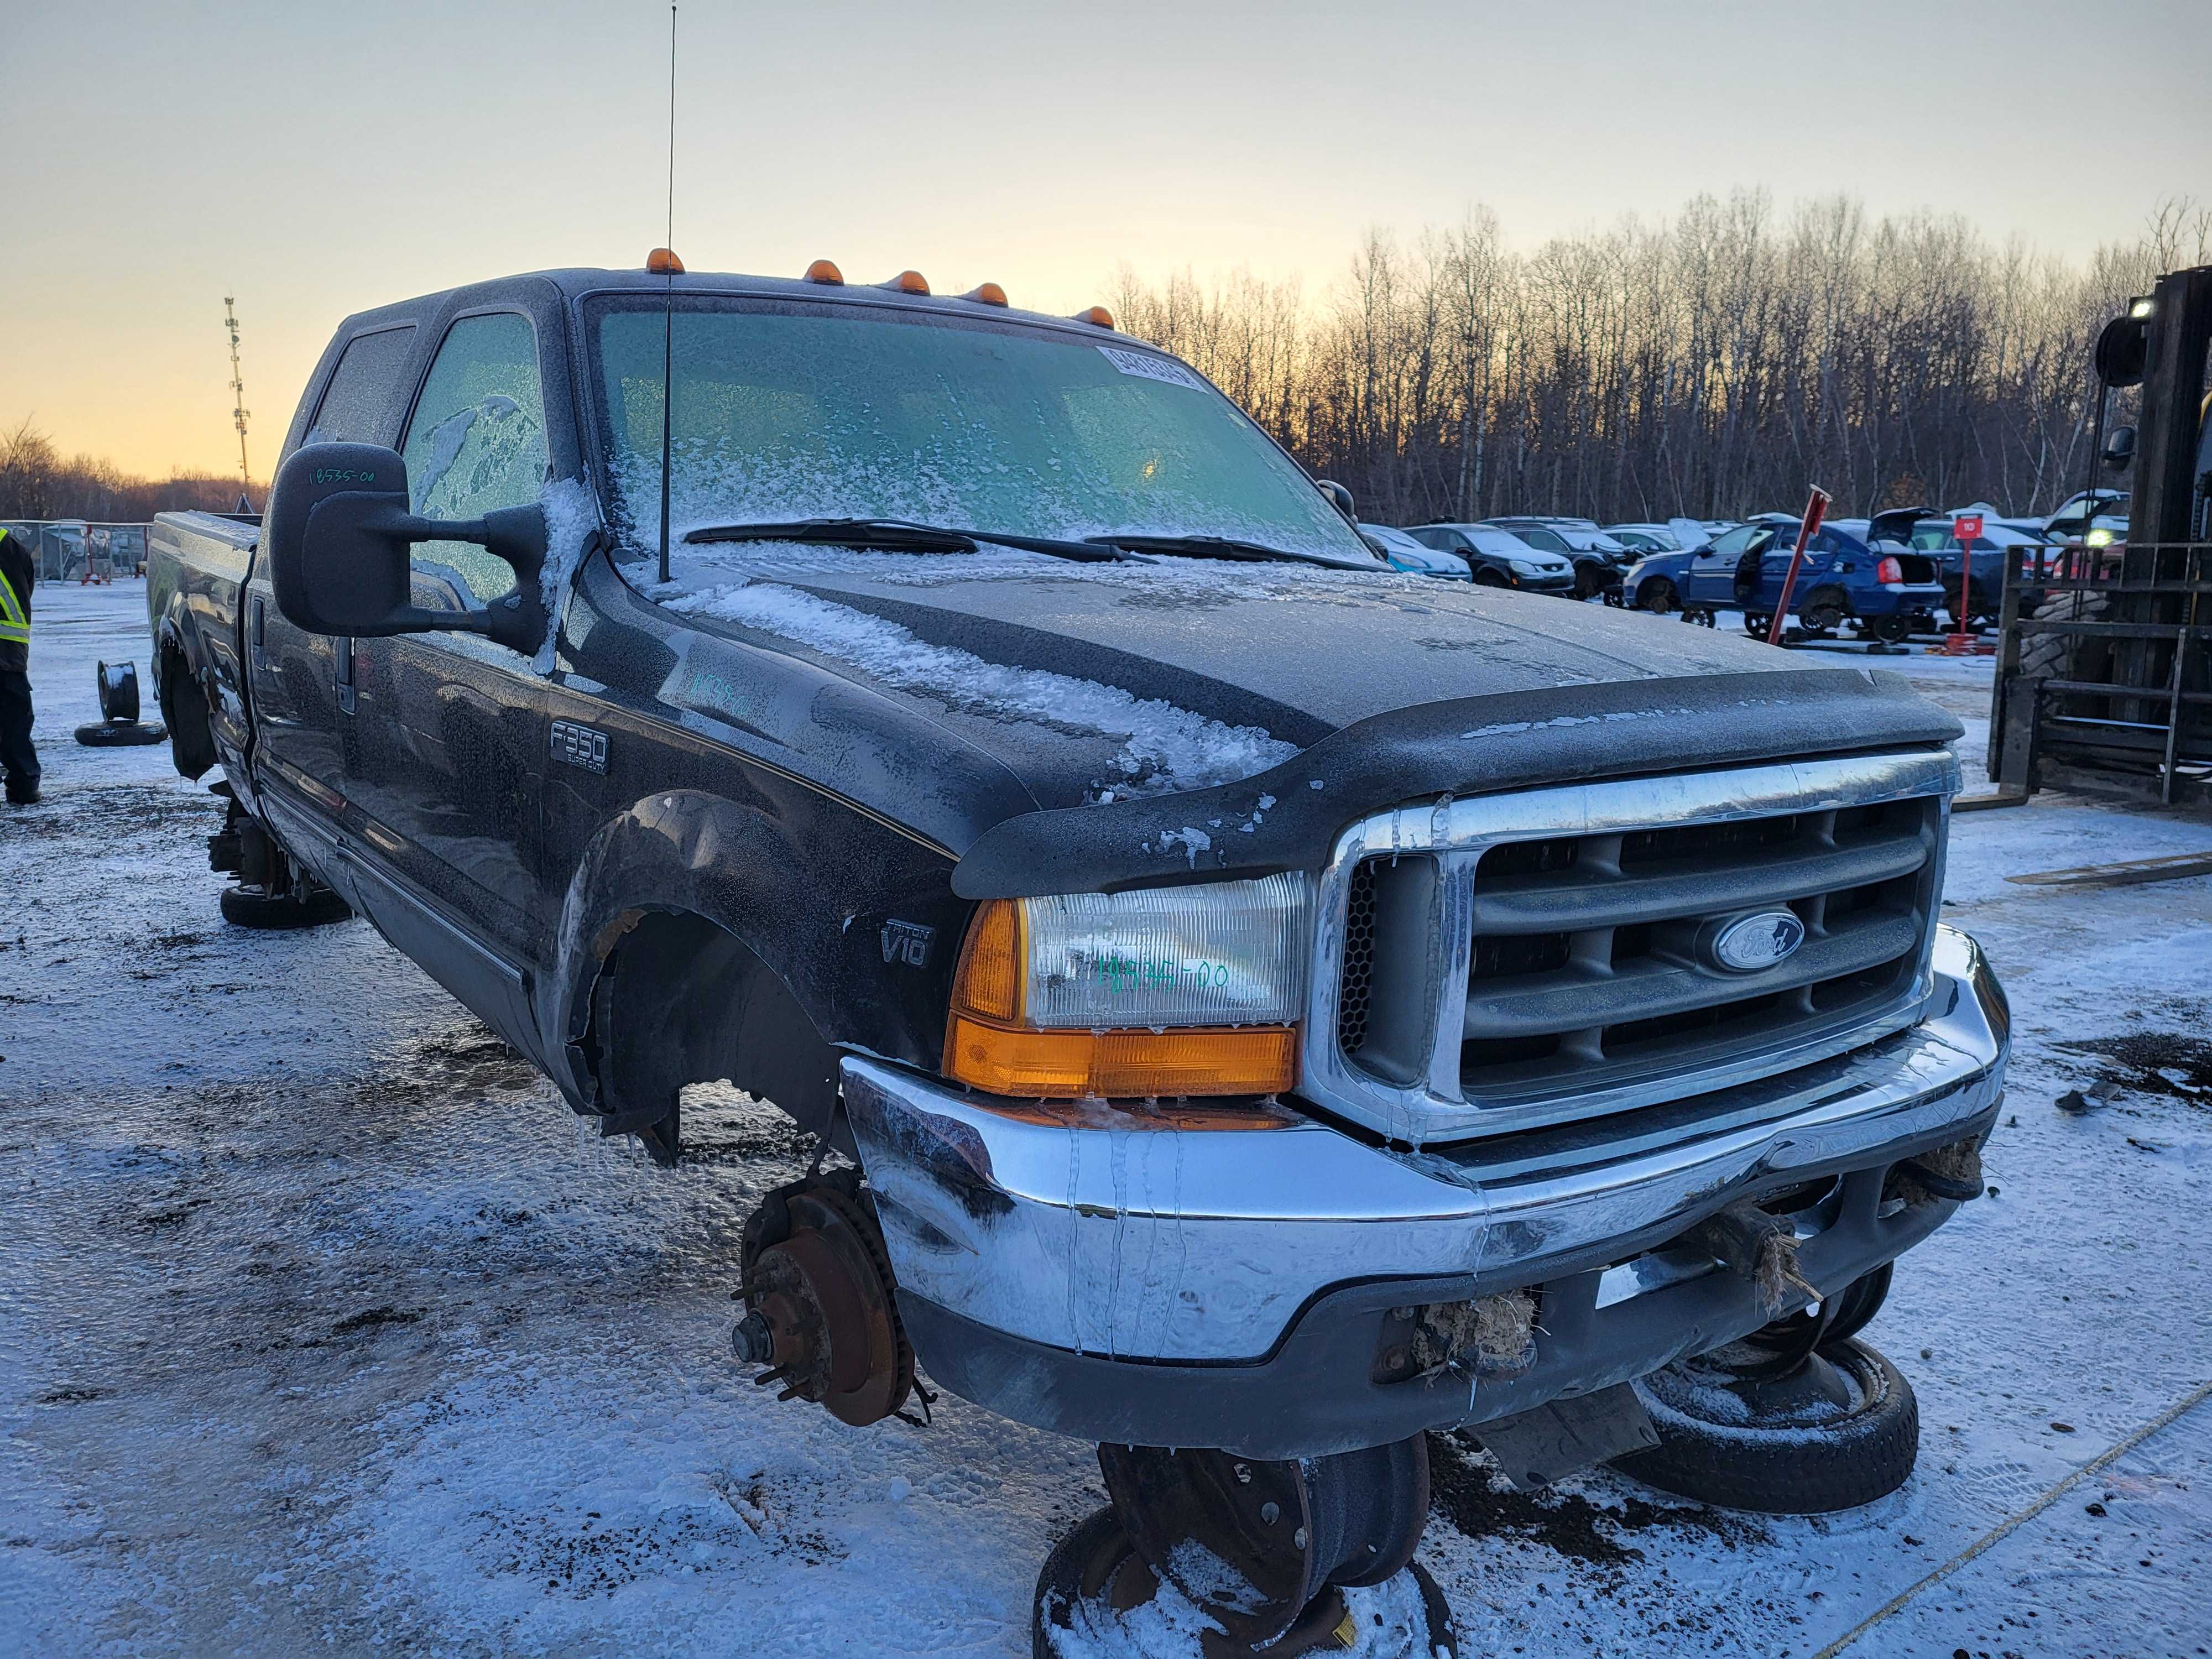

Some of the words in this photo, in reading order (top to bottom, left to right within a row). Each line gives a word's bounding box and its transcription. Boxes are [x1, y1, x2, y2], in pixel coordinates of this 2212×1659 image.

[309, 468, 374, 485] 18535-00
[567, 753, 587, 767] SUPER
[588, 760, 605, 773] DUTY
[885, 921, 930, 940] TRITON
[1742, 925, 1788, 958] Ford
[880, 930, 926, 966] V10
[1098, 954, 1228, 994] 18535-00
